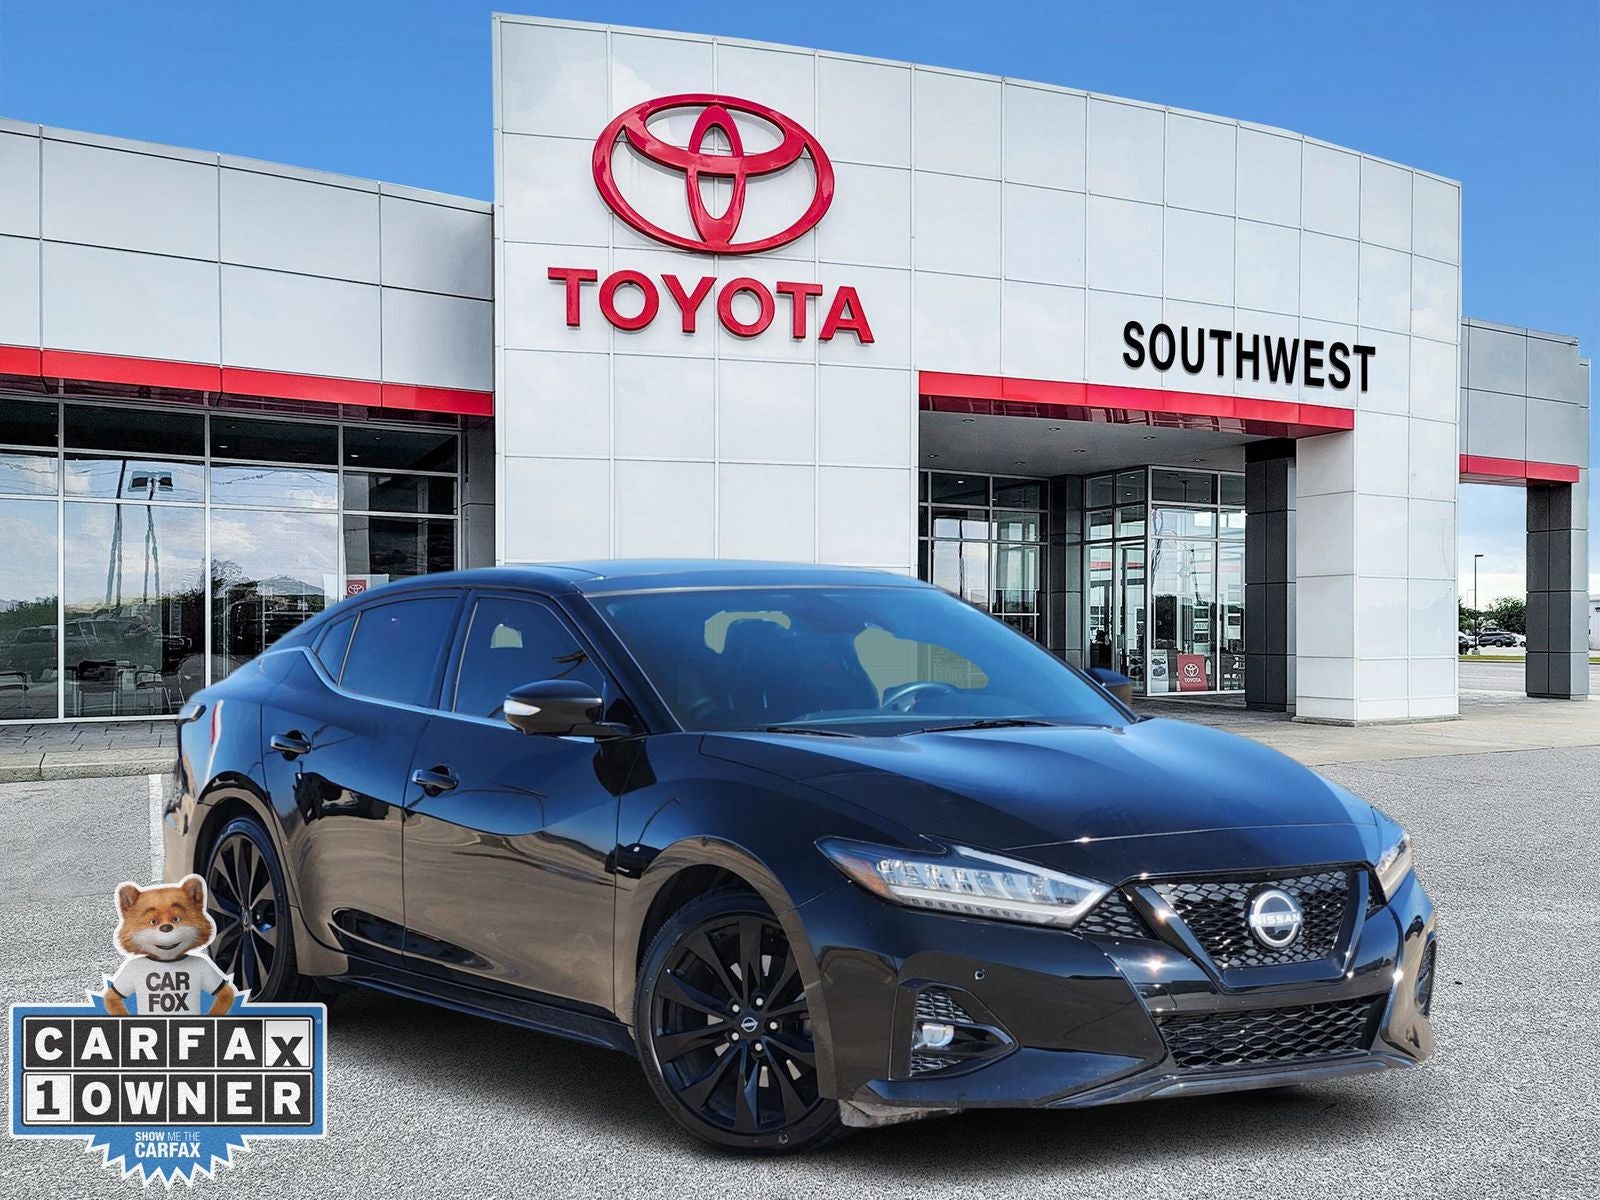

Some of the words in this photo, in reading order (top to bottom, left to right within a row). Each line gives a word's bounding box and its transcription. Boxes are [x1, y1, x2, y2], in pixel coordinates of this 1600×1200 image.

[548, 267, 875, 344] TOYOTA
[1123, 321, 1376, 392] SOUTHWEST
[1252, 911, 1300, 926] NISSAN
